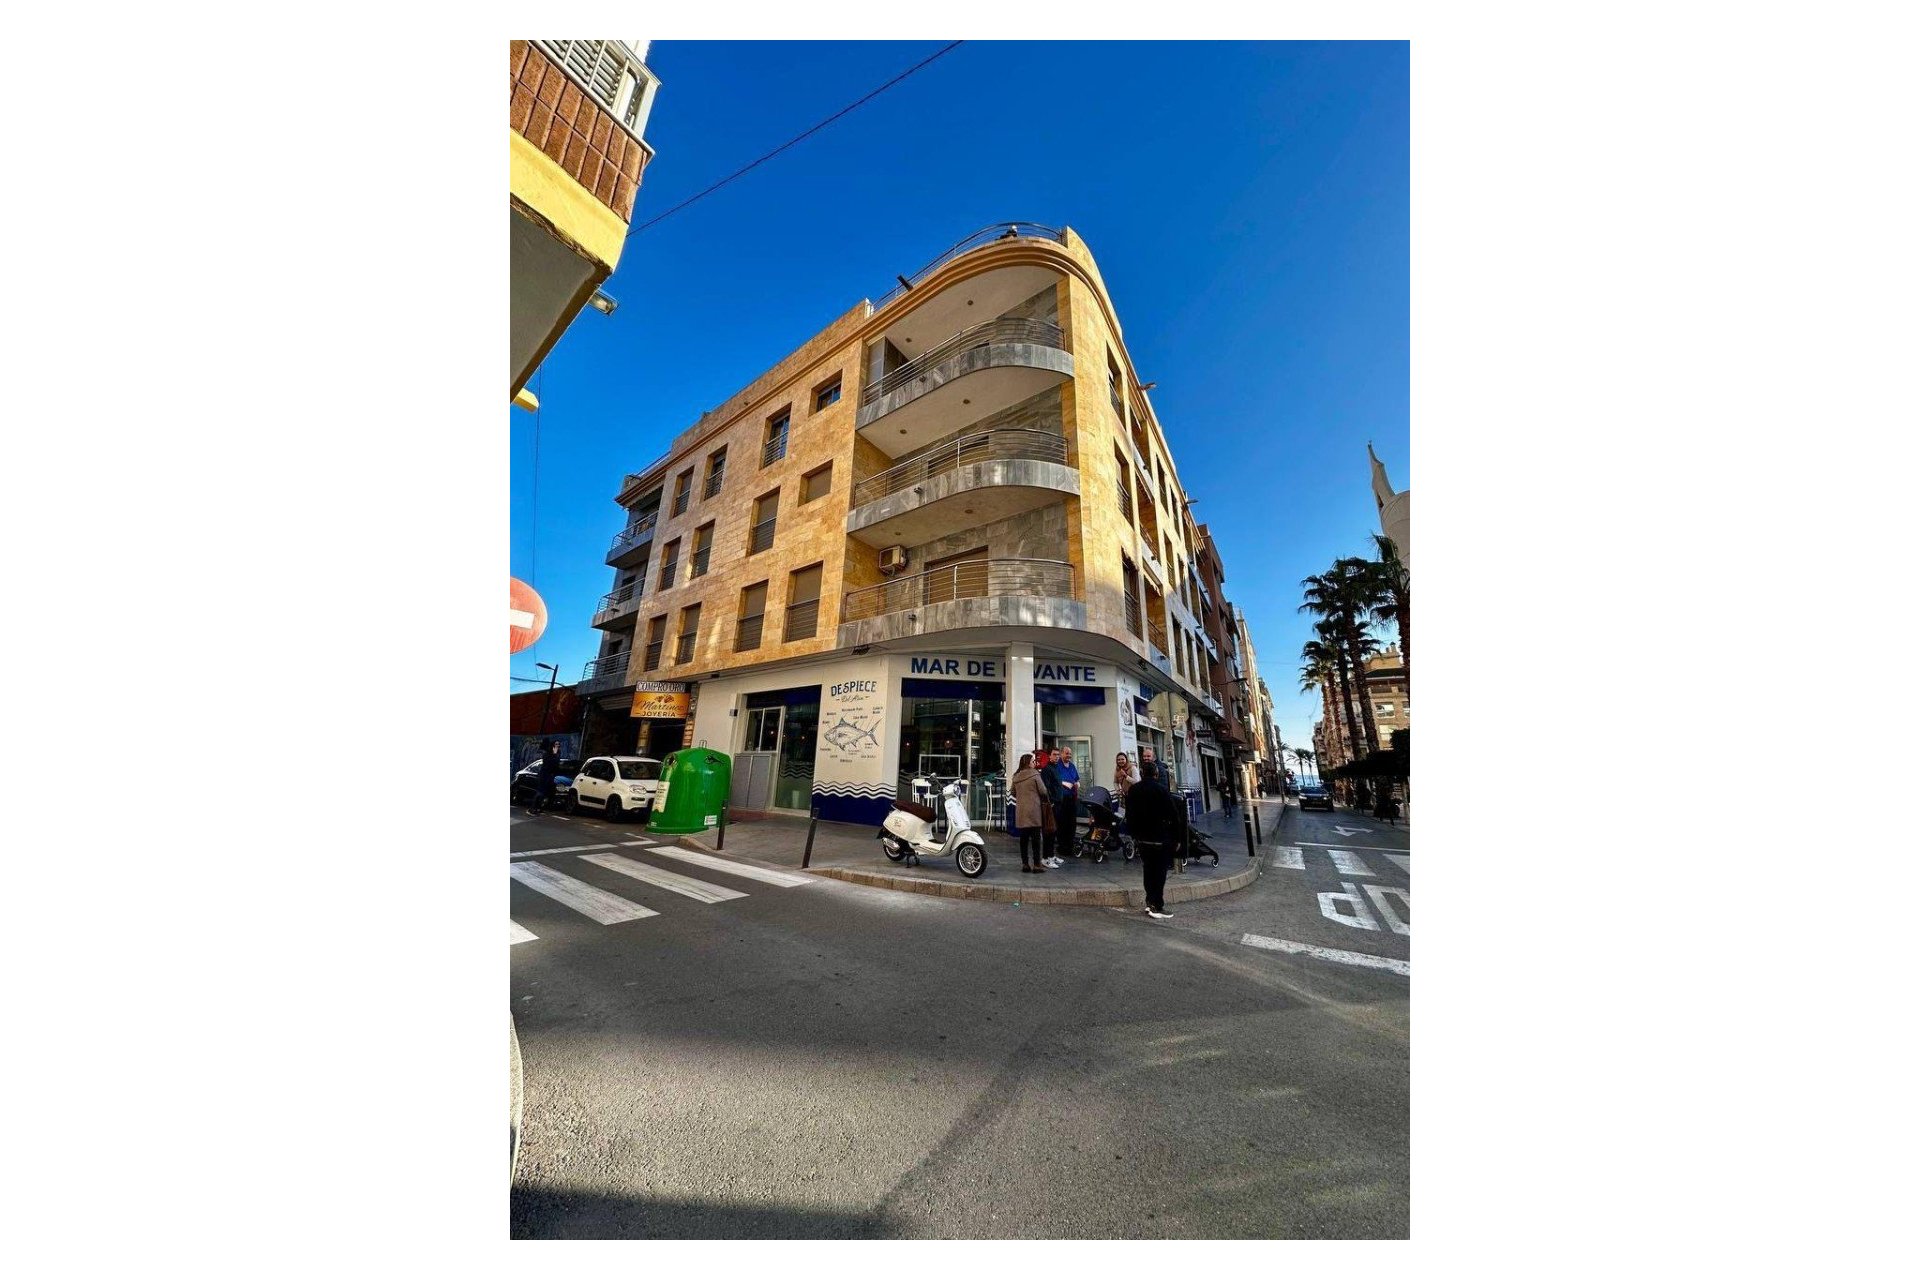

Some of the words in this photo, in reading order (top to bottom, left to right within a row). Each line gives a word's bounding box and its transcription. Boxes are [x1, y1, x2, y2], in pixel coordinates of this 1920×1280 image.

[911, 657, 960, 676] MAR
[967, 660, 996, 677] DE
[1003, 663, 1096, 682] VANTE
[831, 680, 877, 697] DESPIECE
